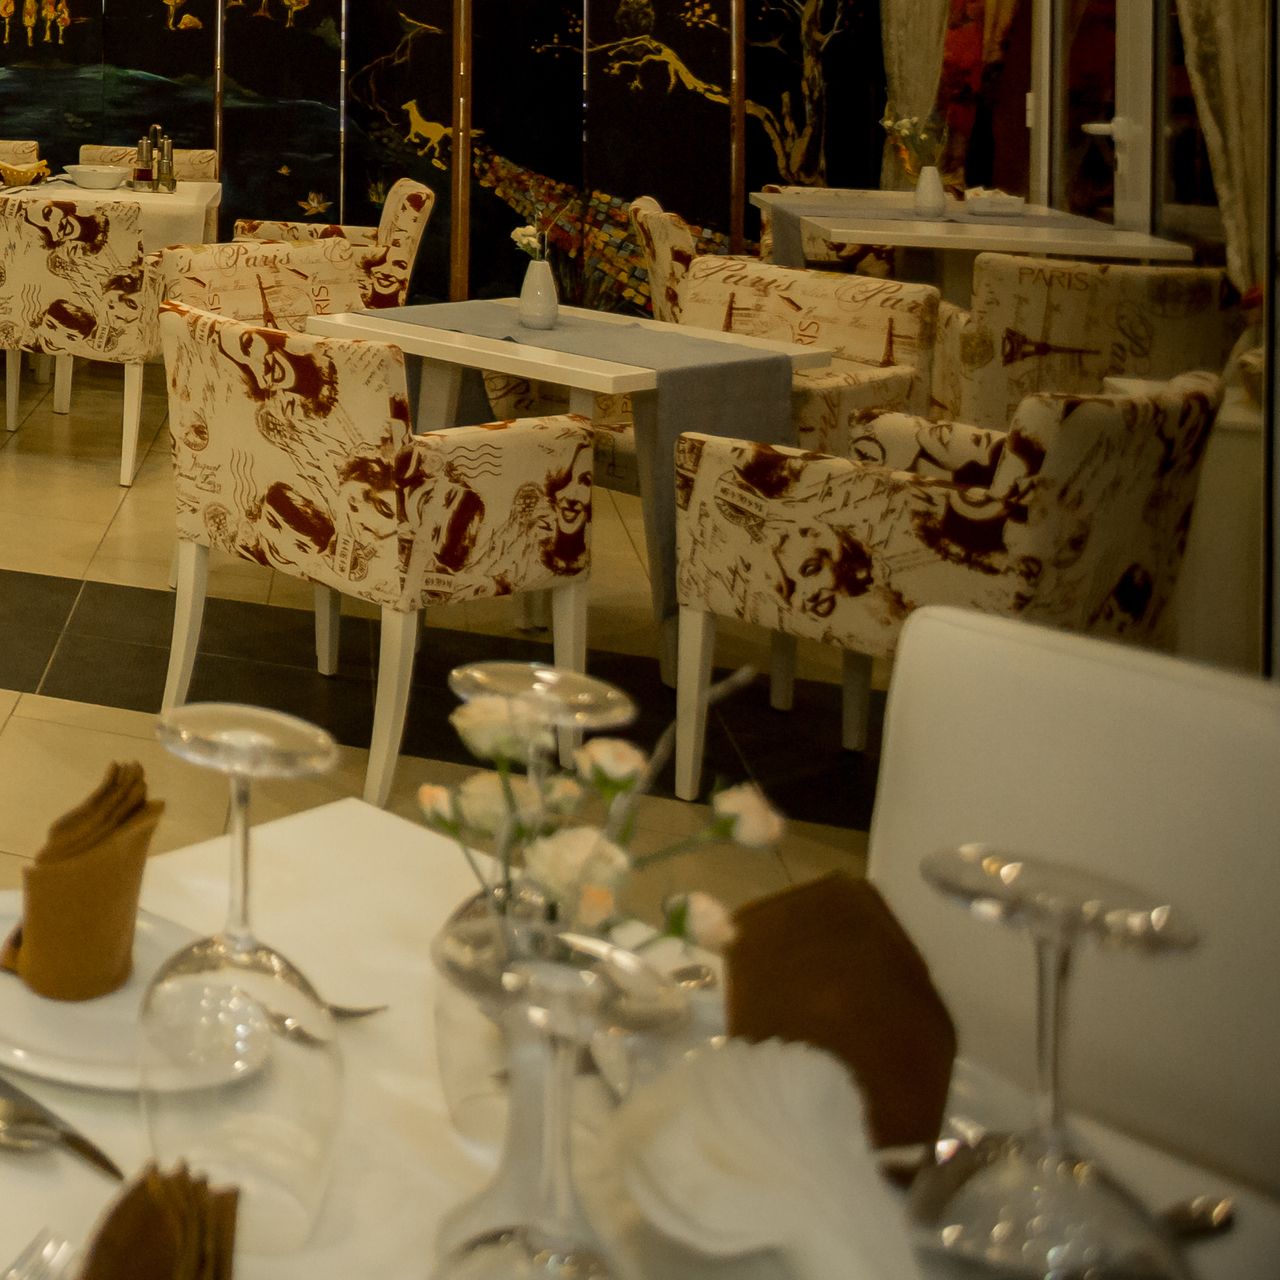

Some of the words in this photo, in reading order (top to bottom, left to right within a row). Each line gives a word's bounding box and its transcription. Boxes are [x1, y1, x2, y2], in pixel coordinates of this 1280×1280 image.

[215, 244, 291, 269] Paris
[693, 258, 797, 293] Paris
[1017, 266, 1091, 293] PARIS
